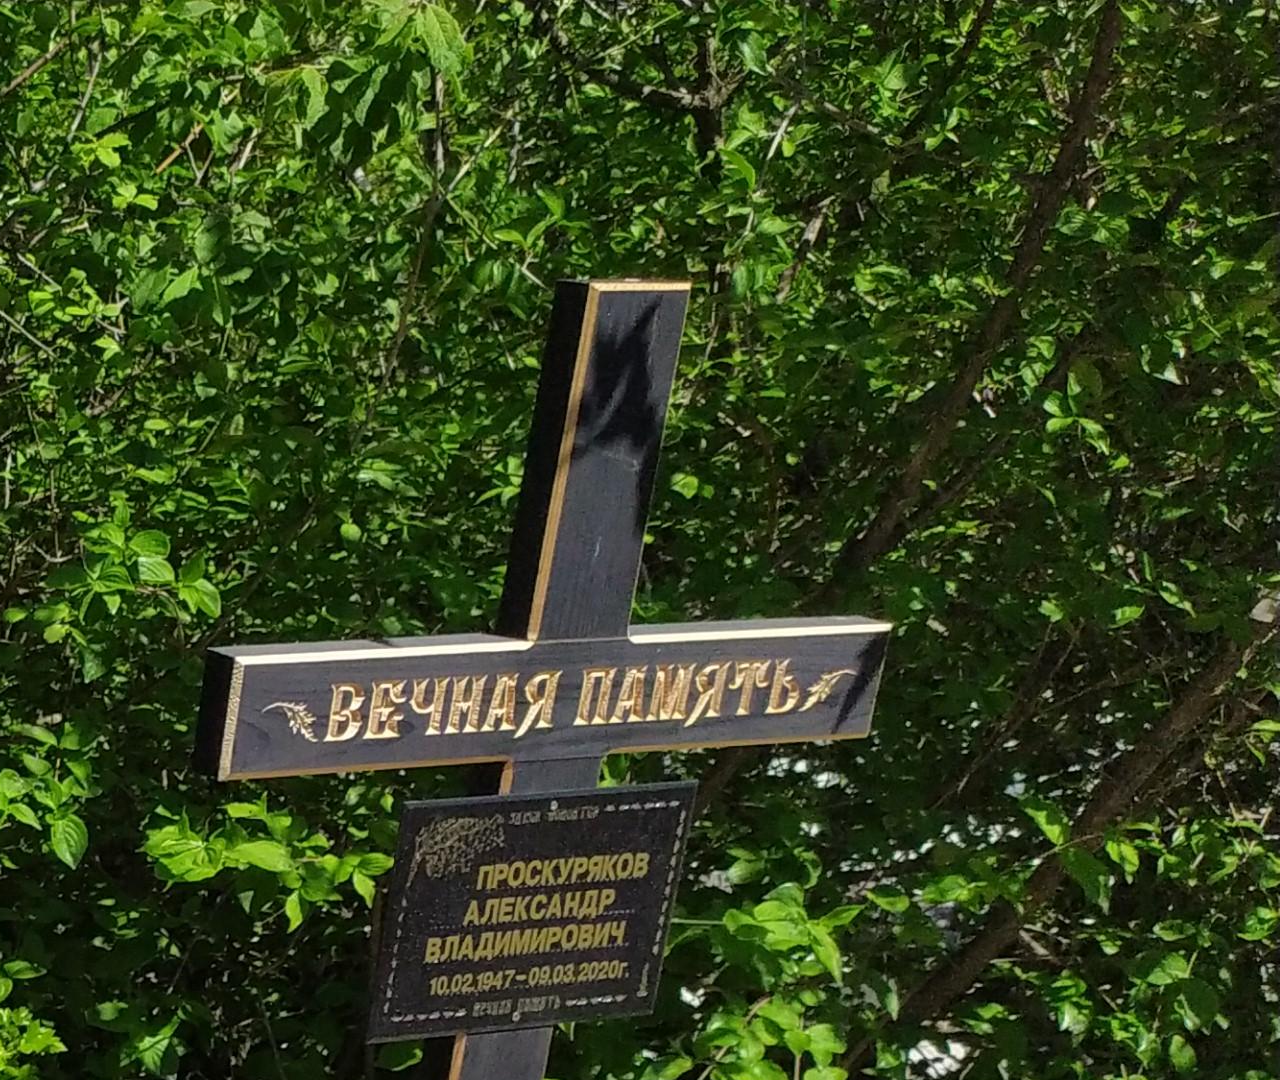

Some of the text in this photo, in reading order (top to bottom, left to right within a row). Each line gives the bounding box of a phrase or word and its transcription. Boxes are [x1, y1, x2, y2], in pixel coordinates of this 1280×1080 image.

[323, 658, 800, 742] ВЕЧНАЯ ПАМЯТЬ
[476, 852, 650, 890] ПРОСКУРЯКОВ
[463, 889, 616, 926] АЛЕКСАНДР
[423, 921, 627, 964] ВЛАДИМИРОВИЧ
